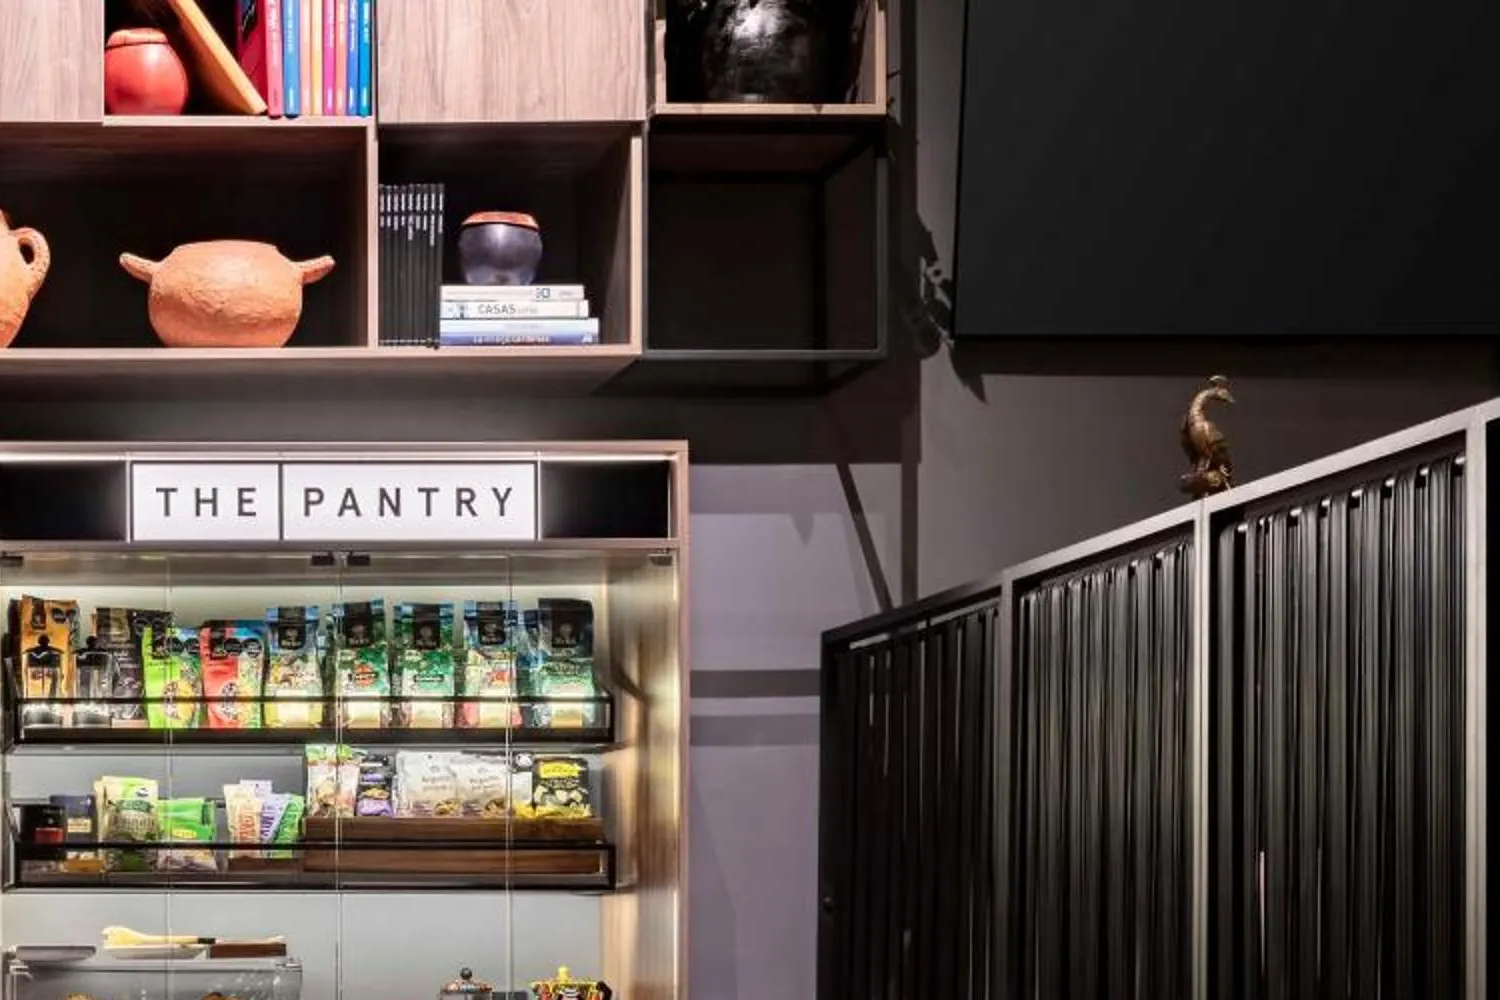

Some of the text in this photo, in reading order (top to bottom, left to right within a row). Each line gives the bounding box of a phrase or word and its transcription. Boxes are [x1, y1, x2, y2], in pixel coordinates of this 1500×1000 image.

[477, 303, 517, 315] CASAS
[156, 488, 512, 517] THE PANTRY
